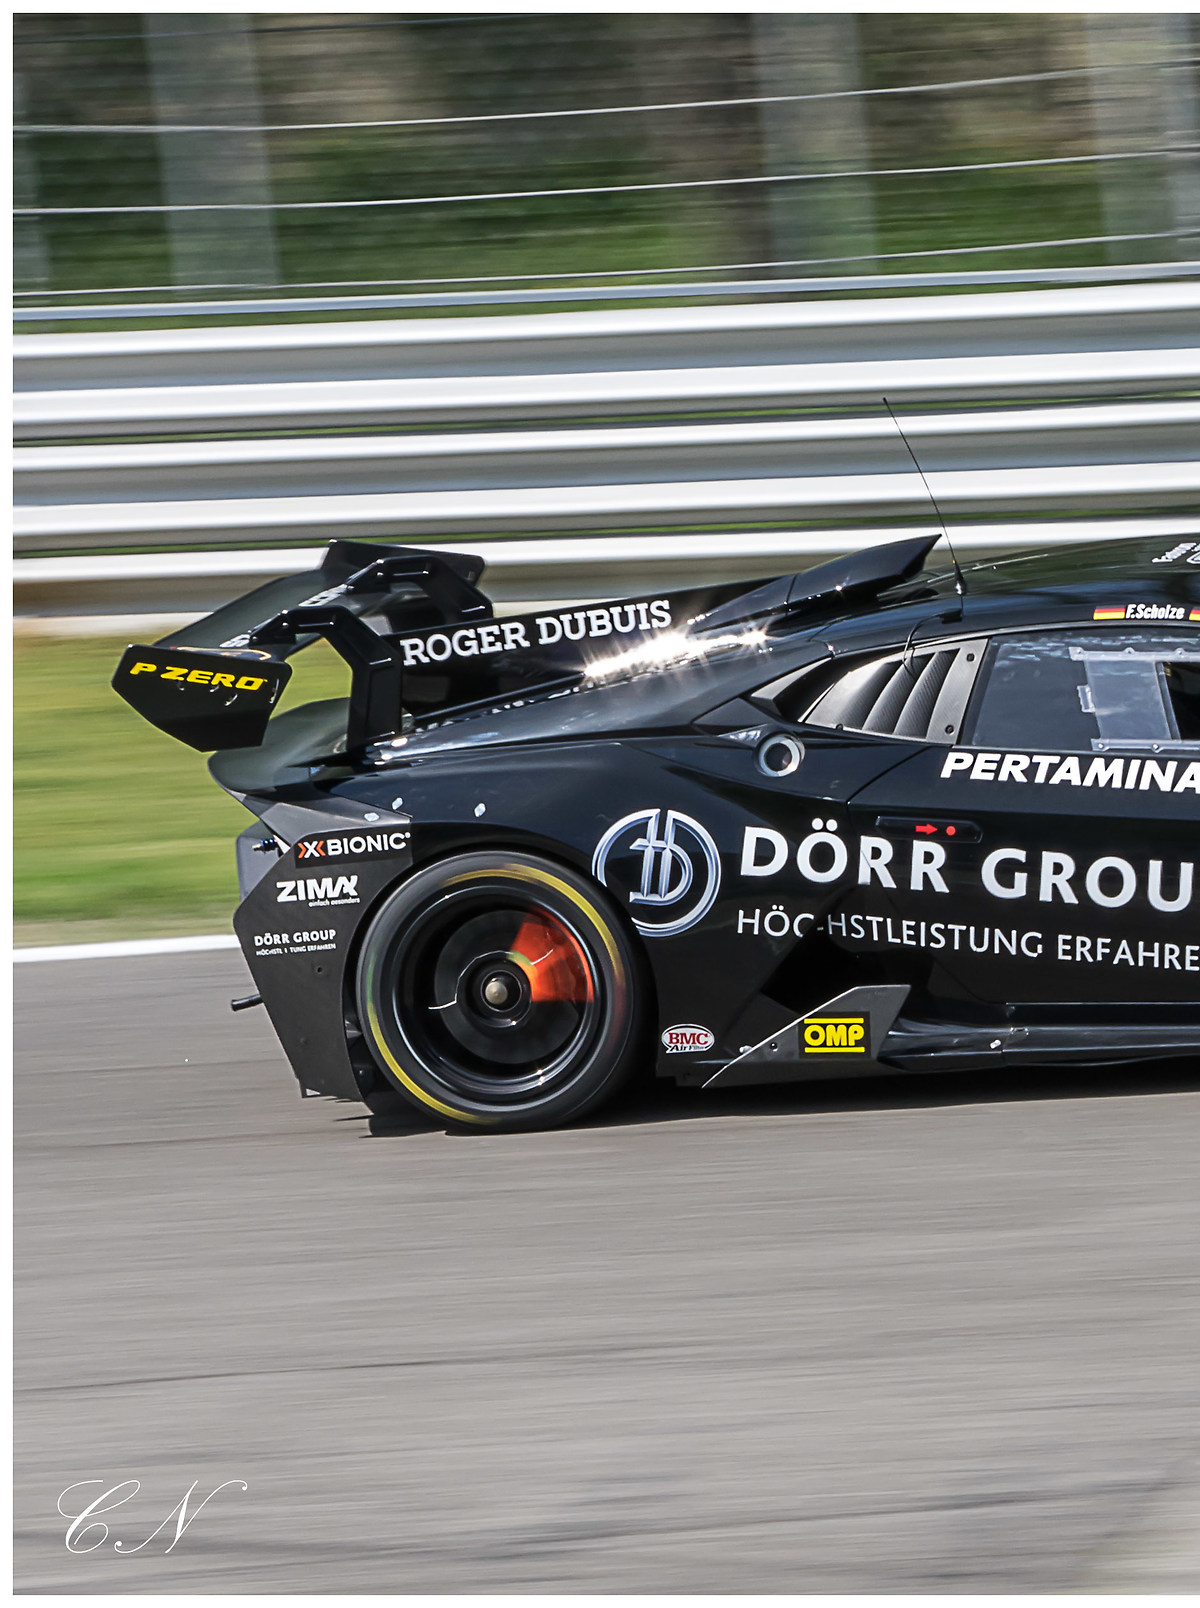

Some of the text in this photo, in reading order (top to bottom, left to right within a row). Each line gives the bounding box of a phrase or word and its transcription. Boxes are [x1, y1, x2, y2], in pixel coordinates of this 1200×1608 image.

[1125, 604, 1185, 620] F.Scholze
[400, 600, 673, 666] ROGER DUBUIS
[129, 663, 262, 691] P ZERO
[740, 818, 949, 894] DÖRR
[254, 929, 337, 946] DÖRR GROUP
[668, 1032, 708, 1045] BMC
[804, 1024, 865, 1047] OMP
